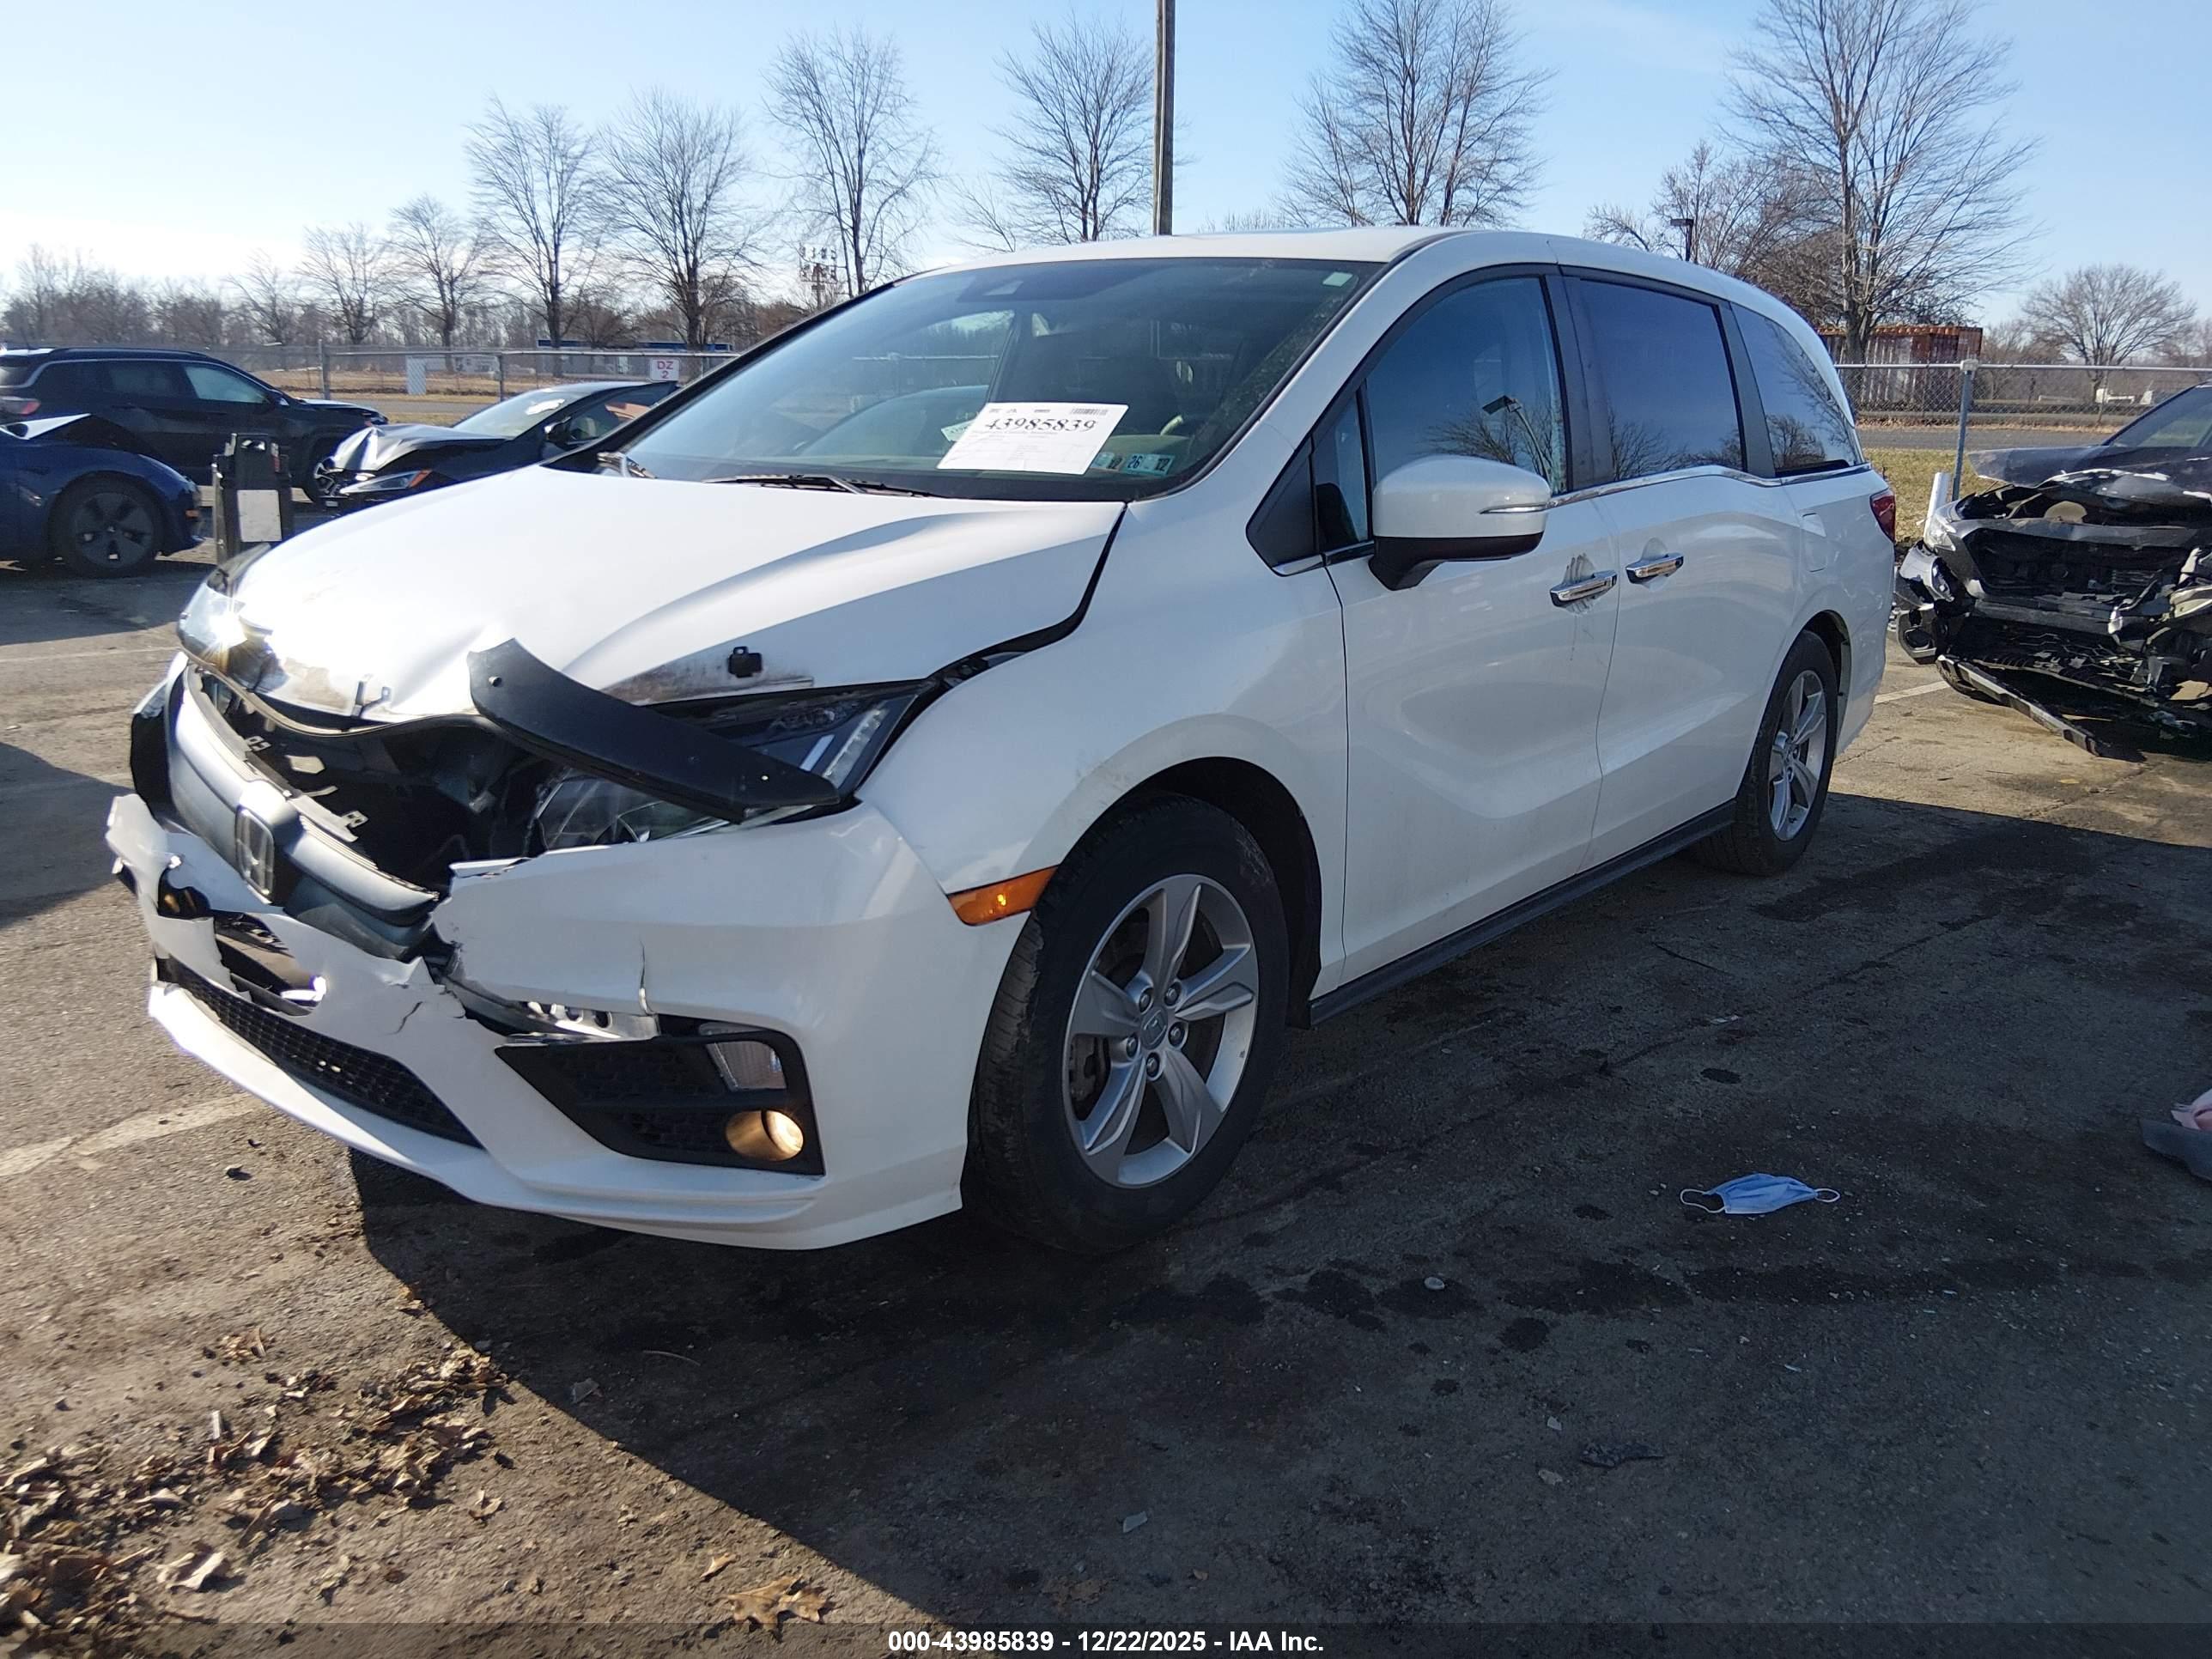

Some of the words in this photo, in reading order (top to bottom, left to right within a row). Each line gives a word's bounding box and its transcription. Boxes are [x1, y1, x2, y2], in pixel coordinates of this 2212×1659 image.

[657, 361, 674, 370] DZ
[661, 370, 669, 380] 2
[985, 417, 1098, 432] 43985839
[1127, 454, 1144, 469] 26
[1153, 458, 1171, 472] 12
